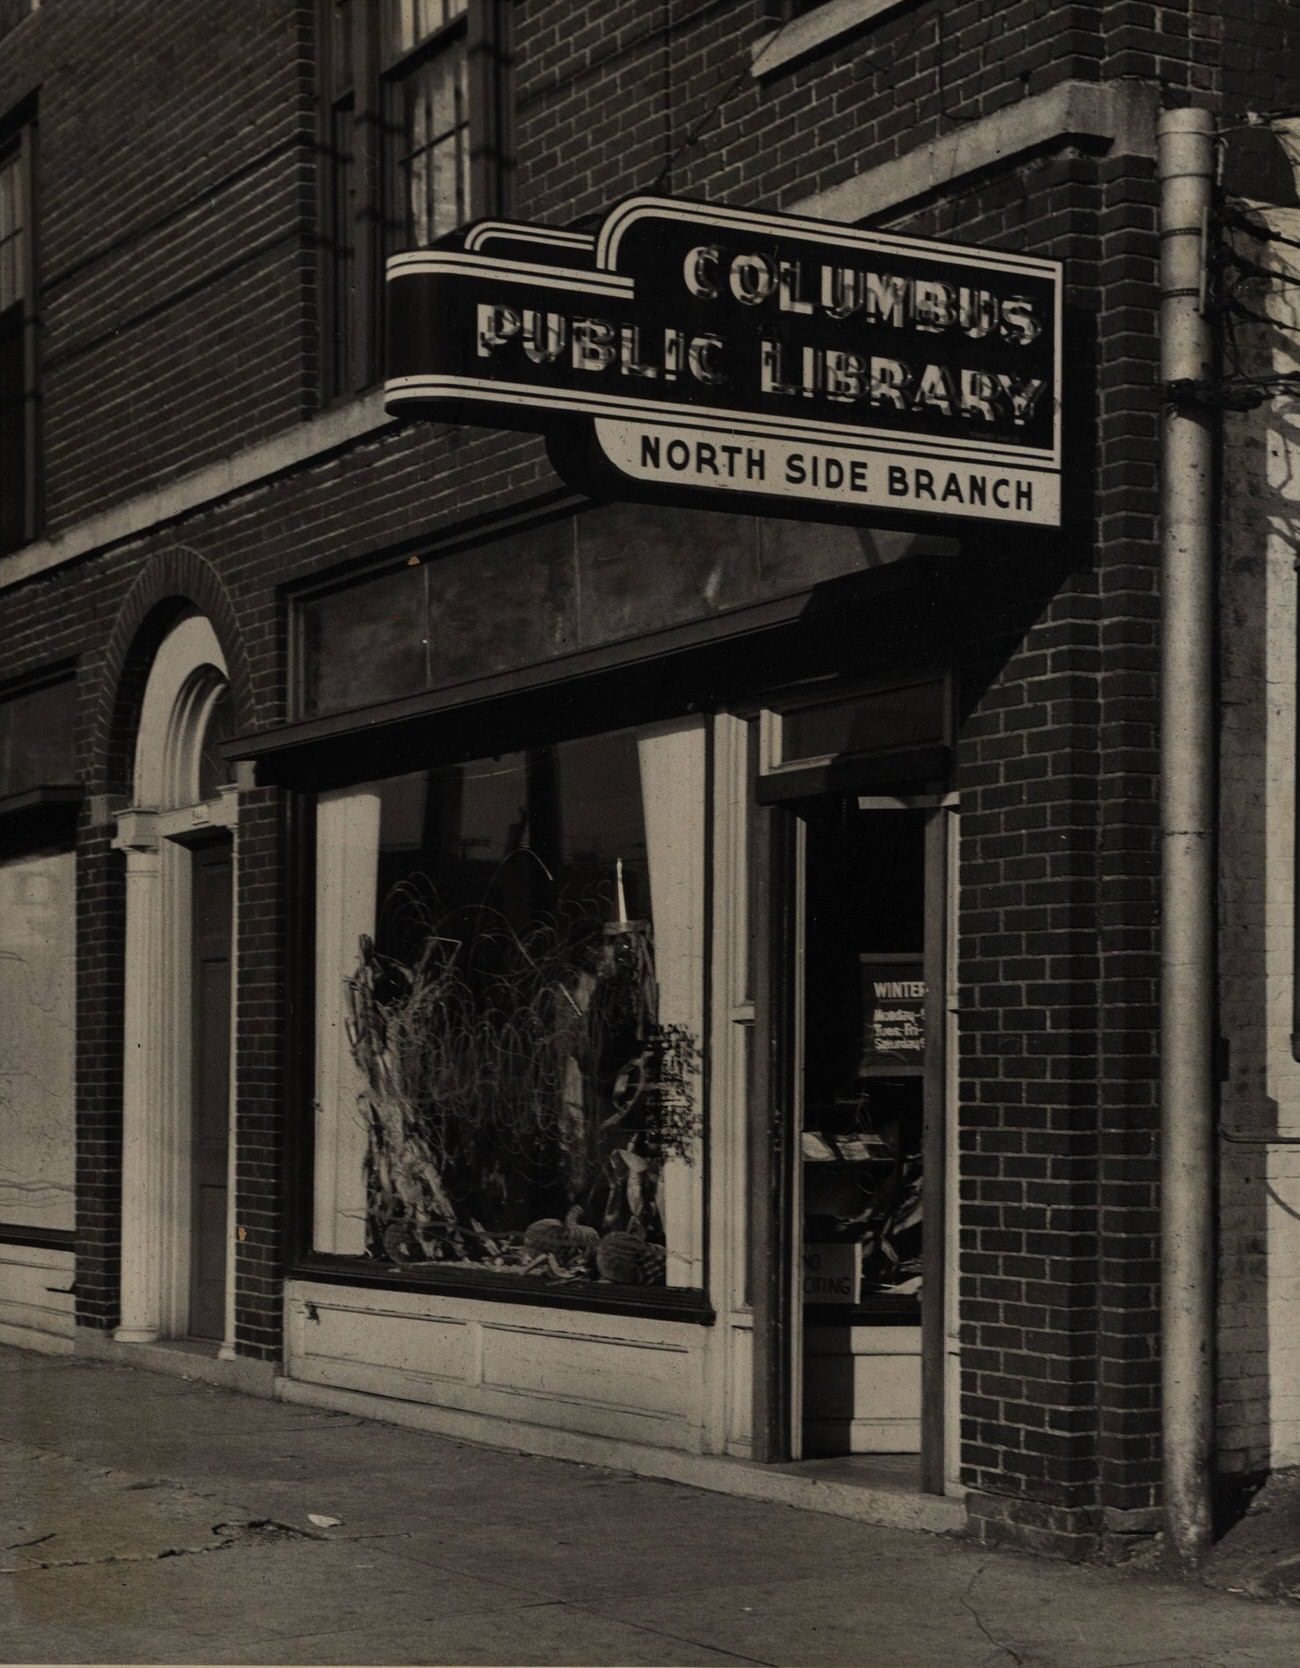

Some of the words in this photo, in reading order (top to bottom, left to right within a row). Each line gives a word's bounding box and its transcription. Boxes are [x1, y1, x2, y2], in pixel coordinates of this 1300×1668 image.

[683, 244, 1042, 346] COLUMBUS
[476, 303, 727, 385] PUBLIC
[759, 335, 1044, 426] LIBRARY
[641, 435, 766, 481] NORTH
[786, 453, 869, 493] SIDE
[888, 465, 1034, 513] BRANCH
